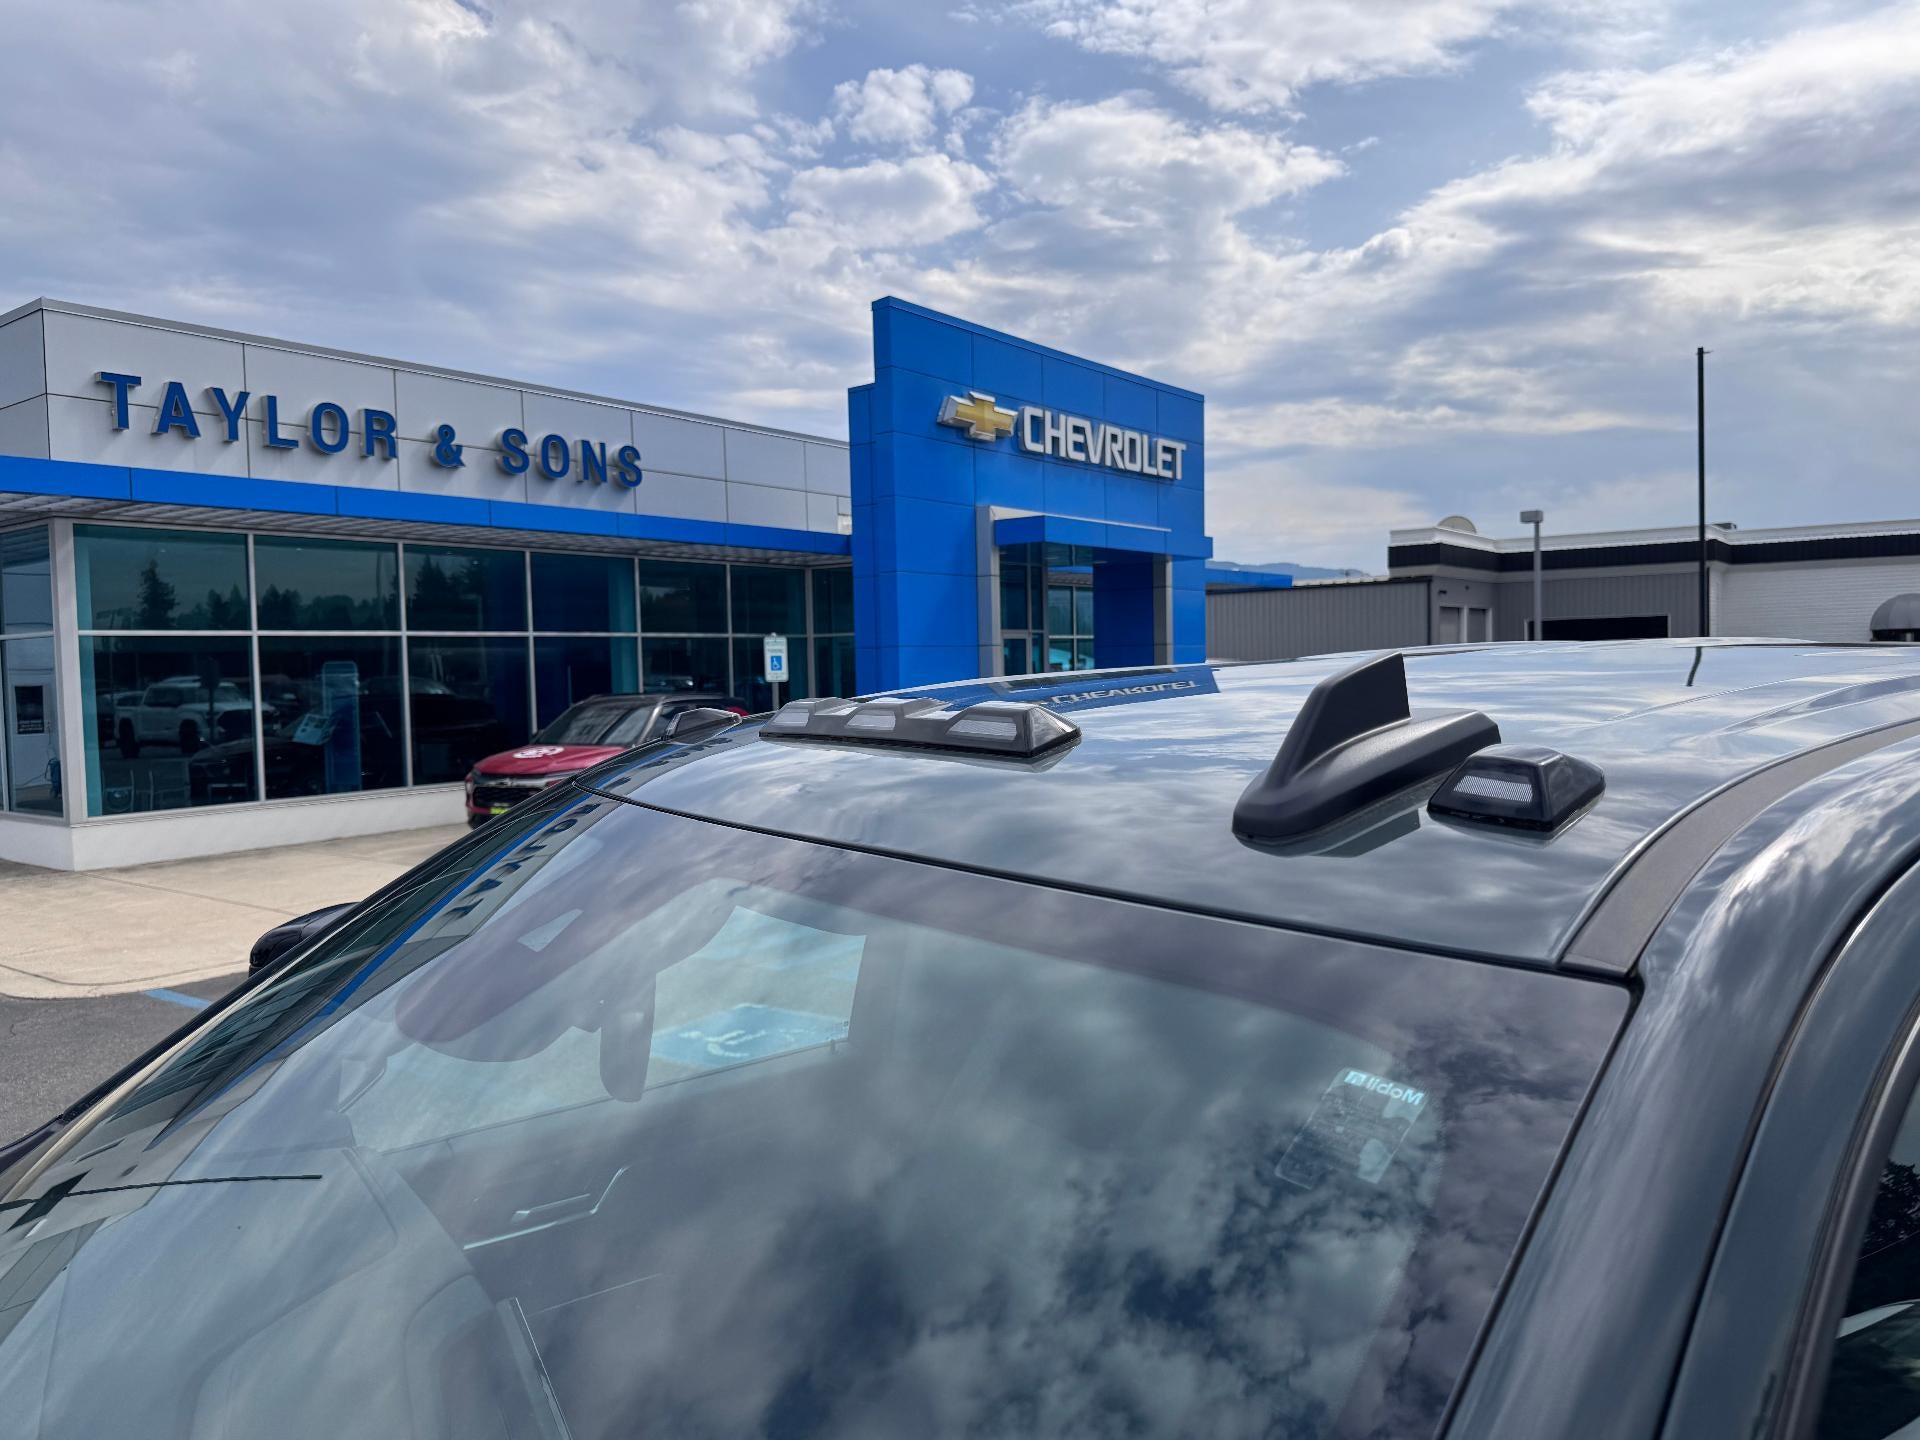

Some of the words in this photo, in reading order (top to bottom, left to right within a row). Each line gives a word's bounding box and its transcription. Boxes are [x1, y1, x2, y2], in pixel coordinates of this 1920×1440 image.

[96, 371, 398, 459] TAYLOR
[431, 424, 466, 468] &
[497, 428, 643, 488] SONS
[1022, 406, 1187, 480] CHEVROLET
